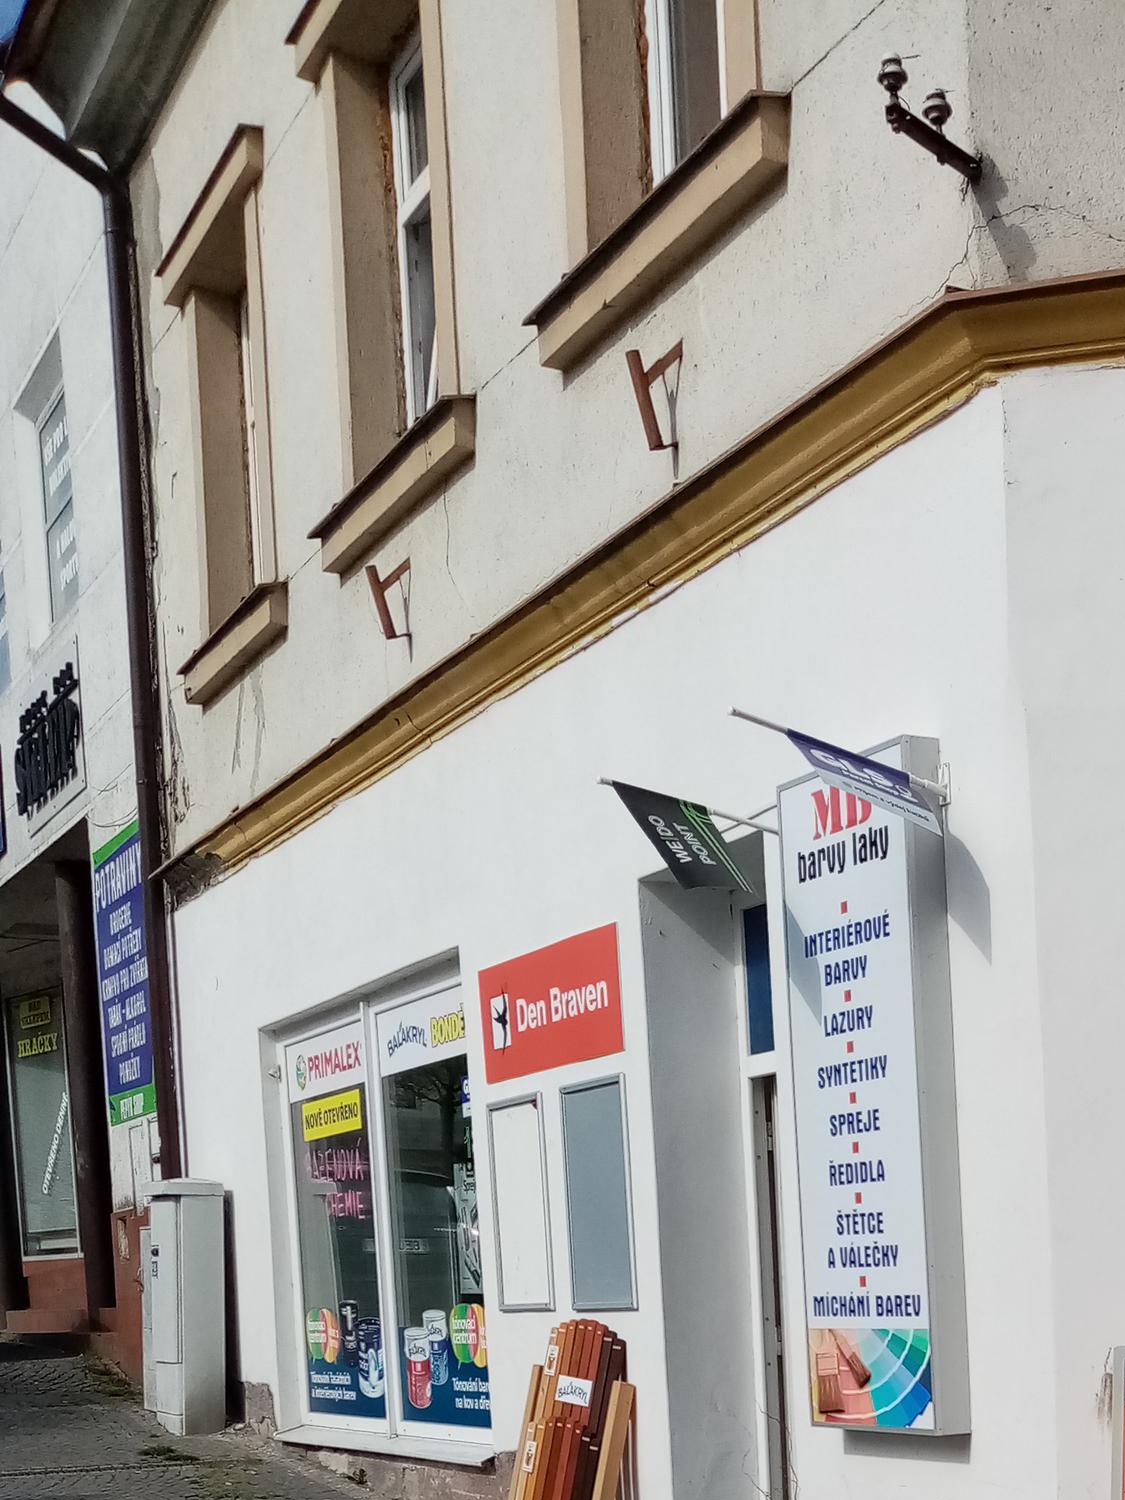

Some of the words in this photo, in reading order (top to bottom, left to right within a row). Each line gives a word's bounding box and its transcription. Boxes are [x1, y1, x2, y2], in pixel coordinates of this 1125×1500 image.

[672, 822, 717, 865] POINT
[797, 840, 846, 884] barvy
[851, 825, 889, 866] laky
[95, 841, 142, 914] POTRAVINY
[804, 909, 890, 958] INTERIÉROVÉ
[824, 954, 868, 987] BARVY
[516, 998, 547, 1033] Den
[549, 980, 609, 1023] Braven
[823, 1004, 874, 1038] LAZURY
[18, 1031, 58, 1058] HRAČKY
[308, 1040, 362, 1082] PRIMALEX
[817, 1054, 888, 1090] SYNTETIKY
[305, 1107, 323, 1131] NOVÉ
[323, 1101, 359, 1126] OTEVŘENO
[829, 1108, 881, 1137] SPREJE
[828, 1159, 885, 1187] ŘEDIDLA
[836, 1209, 885, 1236] ŠTĚTCE
[827, 1247, 836, 1269] A
[839, 1241, 899, 1269] VÁLEČKY
[812, 1291, 871, 1318] MÍCHÁNÍ
[875, 1294, 922, 1317] BAREV
